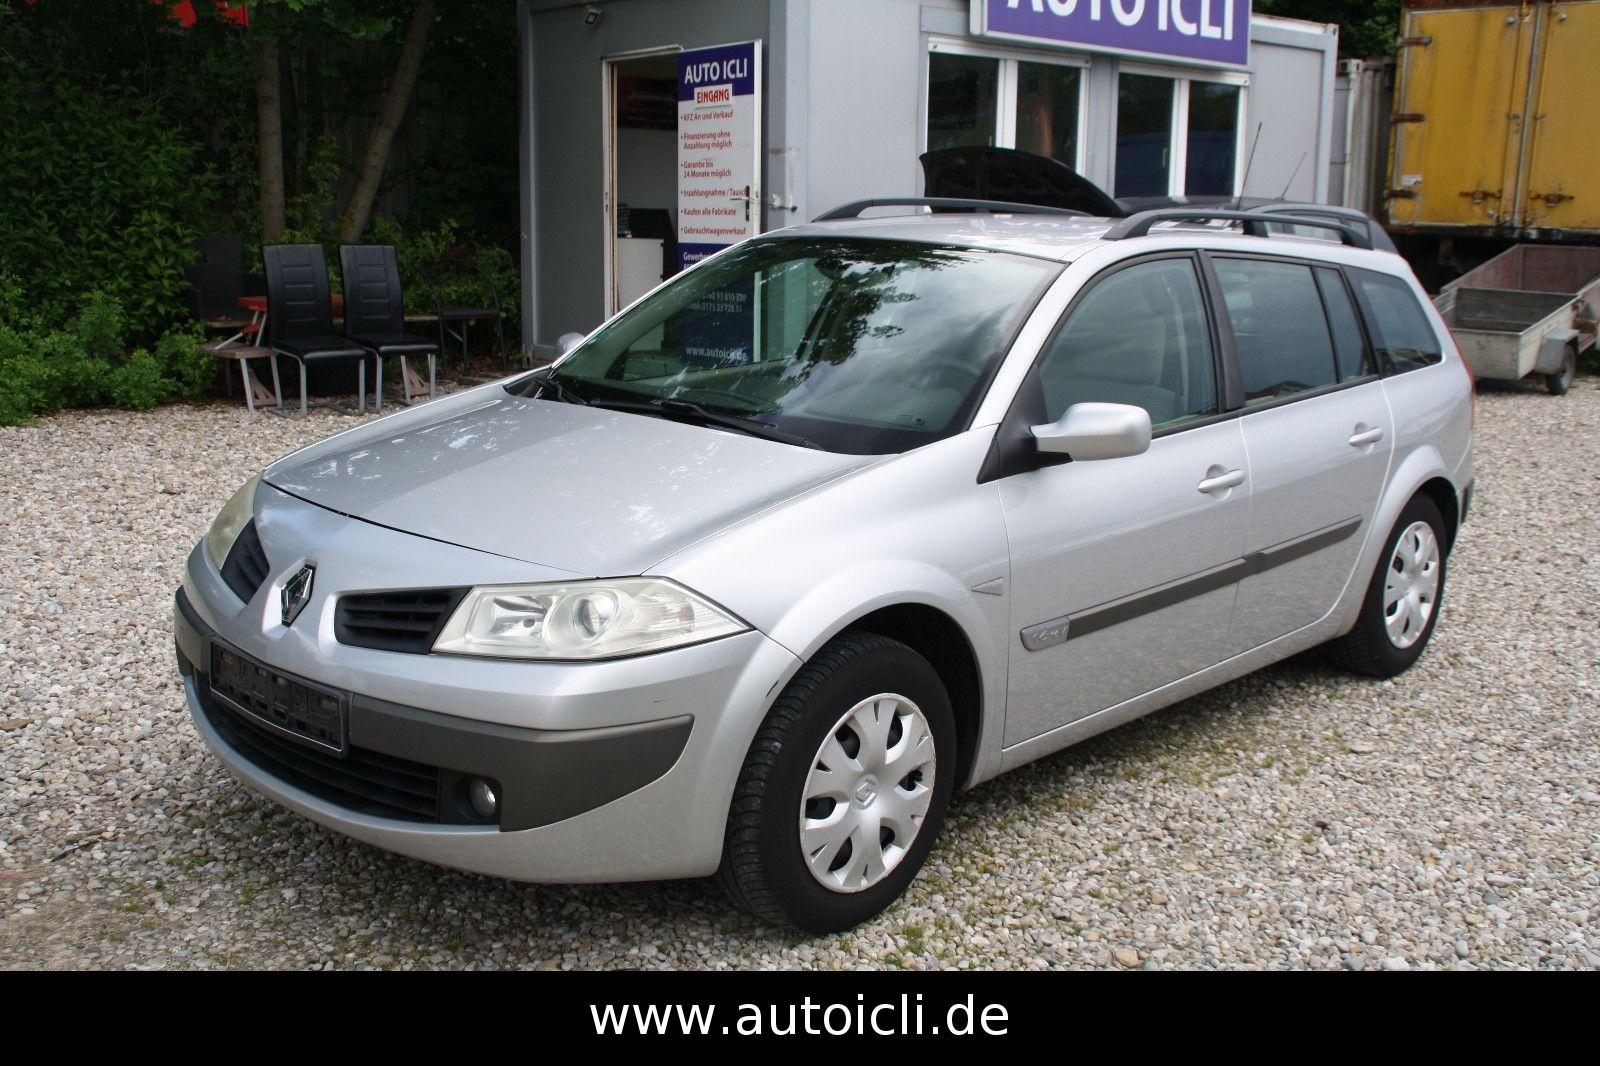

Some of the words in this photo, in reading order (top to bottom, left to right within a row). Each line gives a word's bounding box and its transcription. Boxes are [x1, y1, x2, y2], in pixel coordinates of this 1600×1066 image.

[1158, 0, 1234, 41] ICLI
[684, 61, 720, 84] AUTO
[723, 58, 748, 80] ICLI
[696, 88, 730, 104] EINGANG
[683, 113, 693, 121] KFZ
[694, 112, 701, 120] An
[702, 111, 712, 120] und
[713, 110, 733, 119] Verkauf
[683, 131, 717, 141] Finanzierung
[717, 130, 731, 138] ohne
[683, 142, 711, 151] Anzahlung
[711, 139, 733, 150] möglich
[683, 160, 705, 169] Garantie
[705, 160, 714, 168] bis
[690, 170, 710, 178] Monate
[711, 168, 732, 179] möglich
[683, 188, 726, 198] Inzahlungnahme
[730, 187, 747, 196] Tausc
[683, 208, 701, 216] Kaufen
[702, 207, 711, 216] alle
[711, 207, 737, 216] Fabrikate
[683, 226, 747, 237] Gebrauchtwagenverkauf
